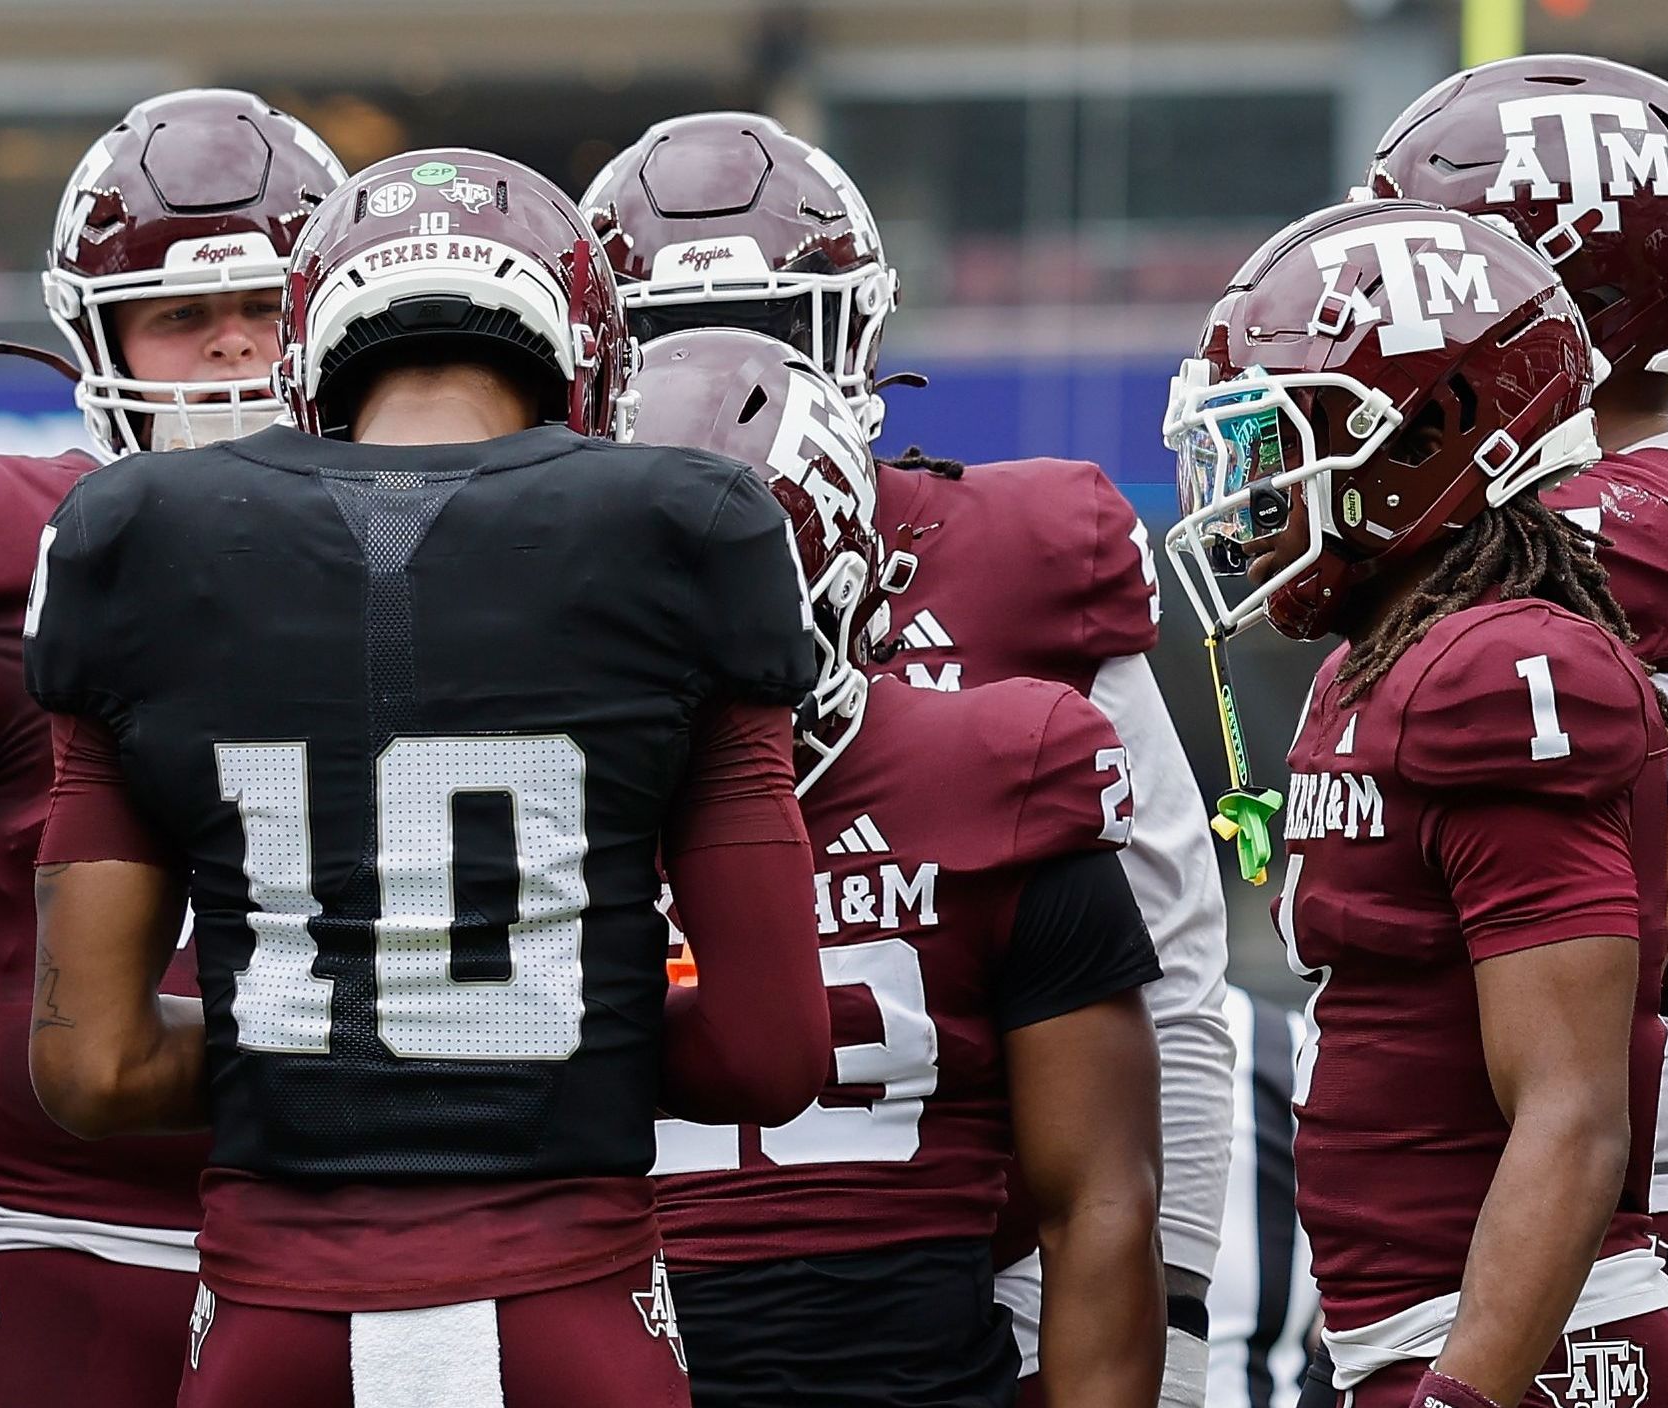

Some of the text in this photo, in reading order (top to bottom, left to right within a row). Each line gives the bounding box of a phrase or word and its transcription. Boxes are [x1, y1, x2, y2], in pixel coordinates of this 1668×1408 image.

[417, 168, 452, 177] C2P
[372, 185, 412, 214] SEC
[419, 212, 450, 235] 10
[193, 243, 247, 268] Aggies
[365, 243, 493, 272] TEXAS A&M
[678, 246, 734, 272] Aggies
[1515, 654, 1572, 762] 1
[213, 734, 589, 1061] 10
